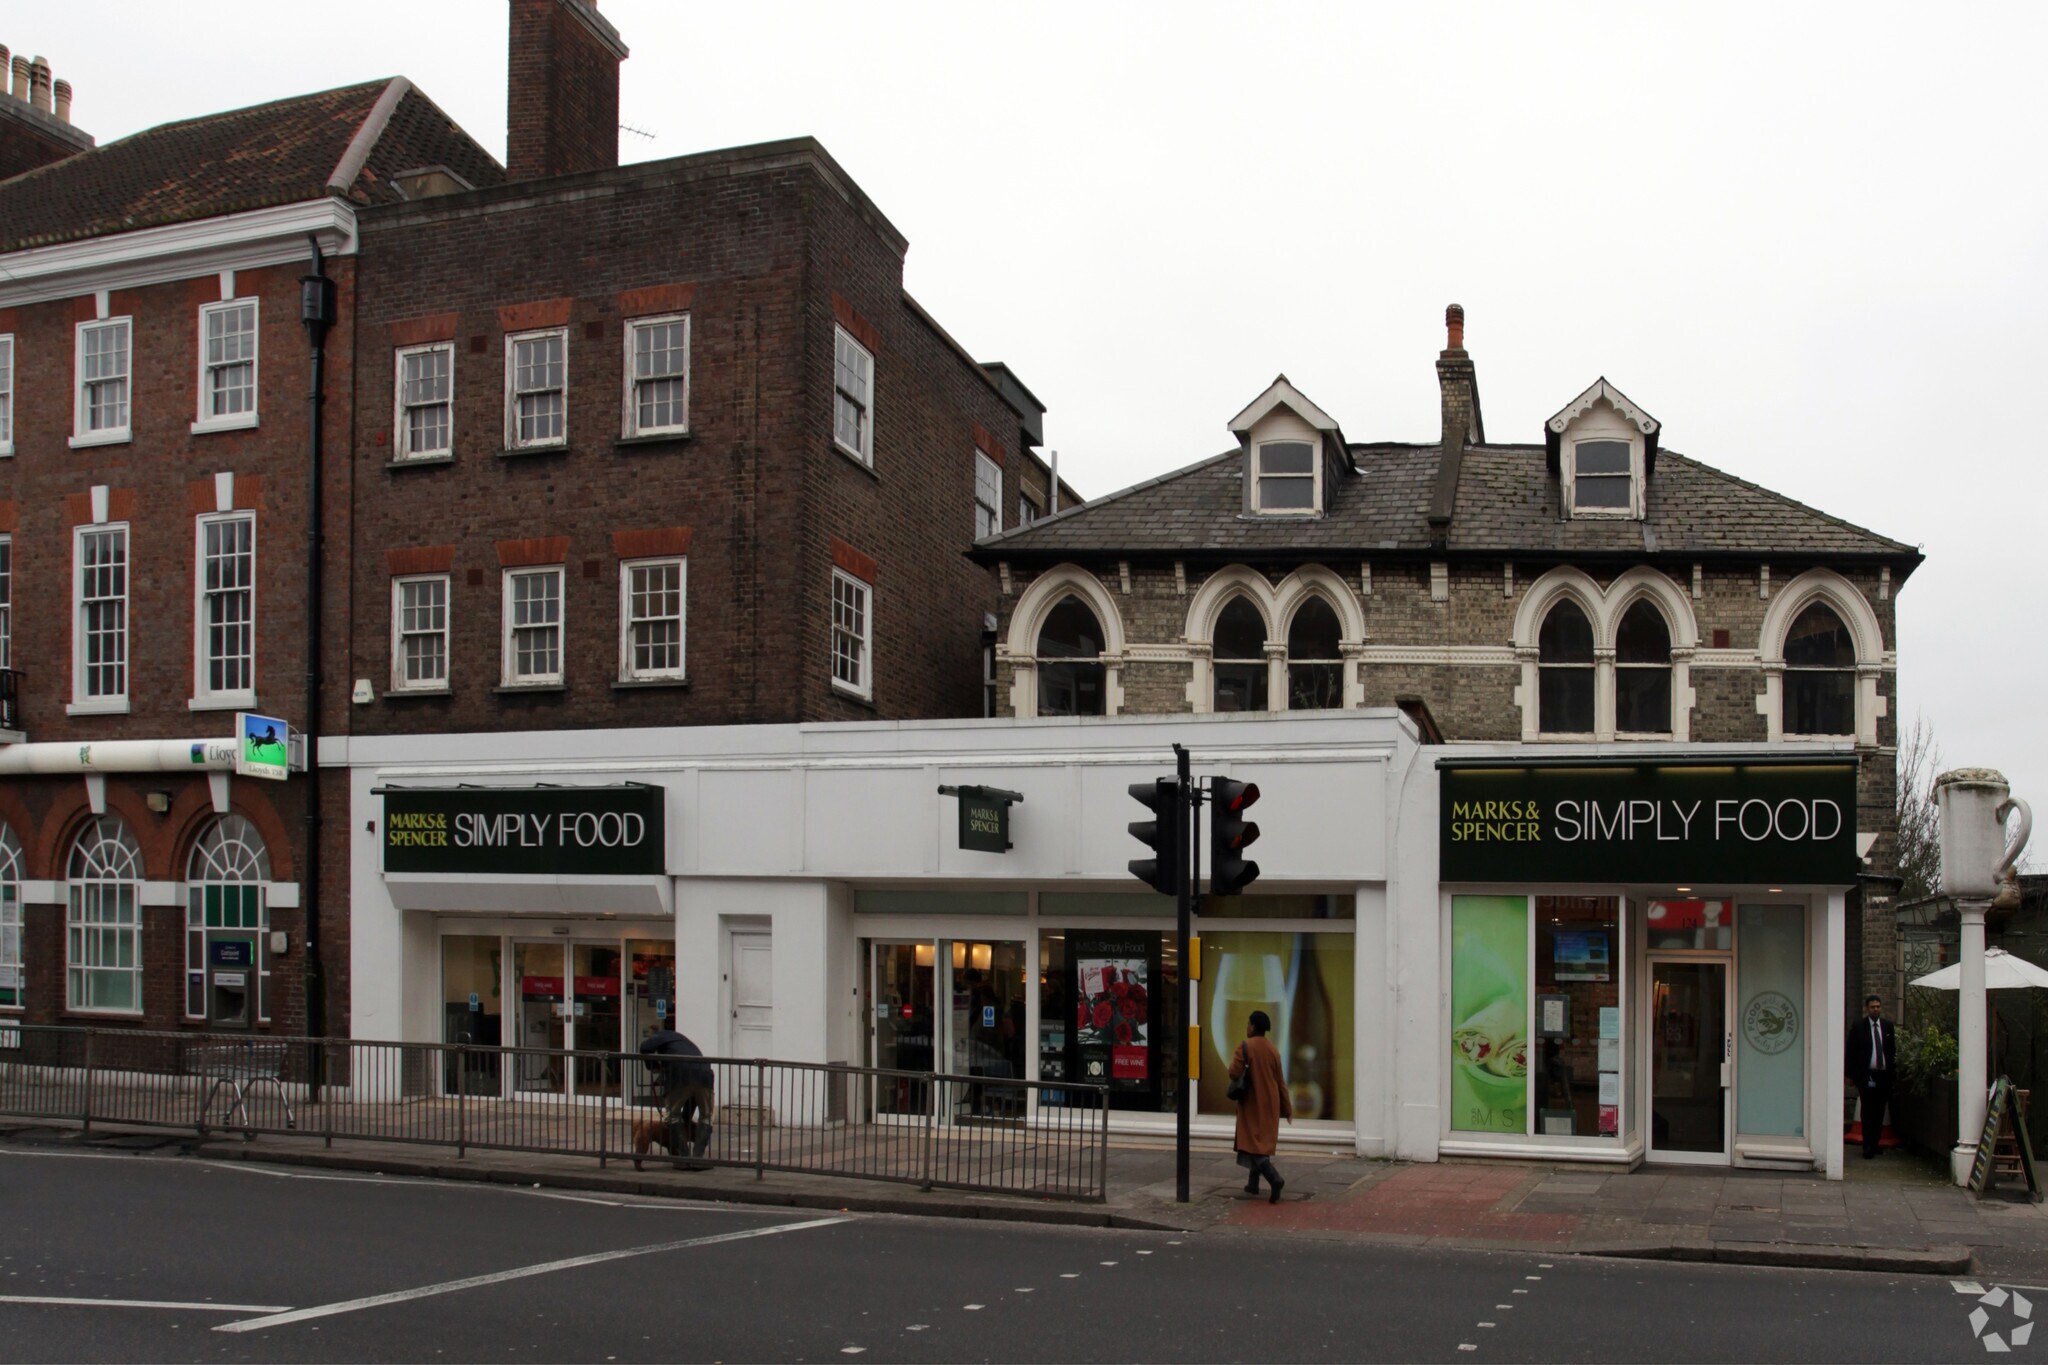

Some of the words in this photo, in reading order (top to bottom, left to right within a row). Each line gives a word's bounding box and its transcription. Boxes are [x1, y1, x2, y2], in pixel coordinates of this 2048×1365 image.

[970, 819, 999, 833] SPENCER
[1554, 799, 1702, 842] SIMPLY
[1714, 798, 1842, 842] FOOD
[454, 812, 551, 847] SIMPLY
[558, 812, 645, 847] FOOD
[1451, 822, 1541, 841] SPENCER
[389, 830, 448, 846] SPENCER
[1099, 941, 1124, 954] Simply
[1125, 941, 1145, 953] Food
[1114, 1058, 1129, 1066] FREE
[1129, 1059, 1145, 1067] WINE
